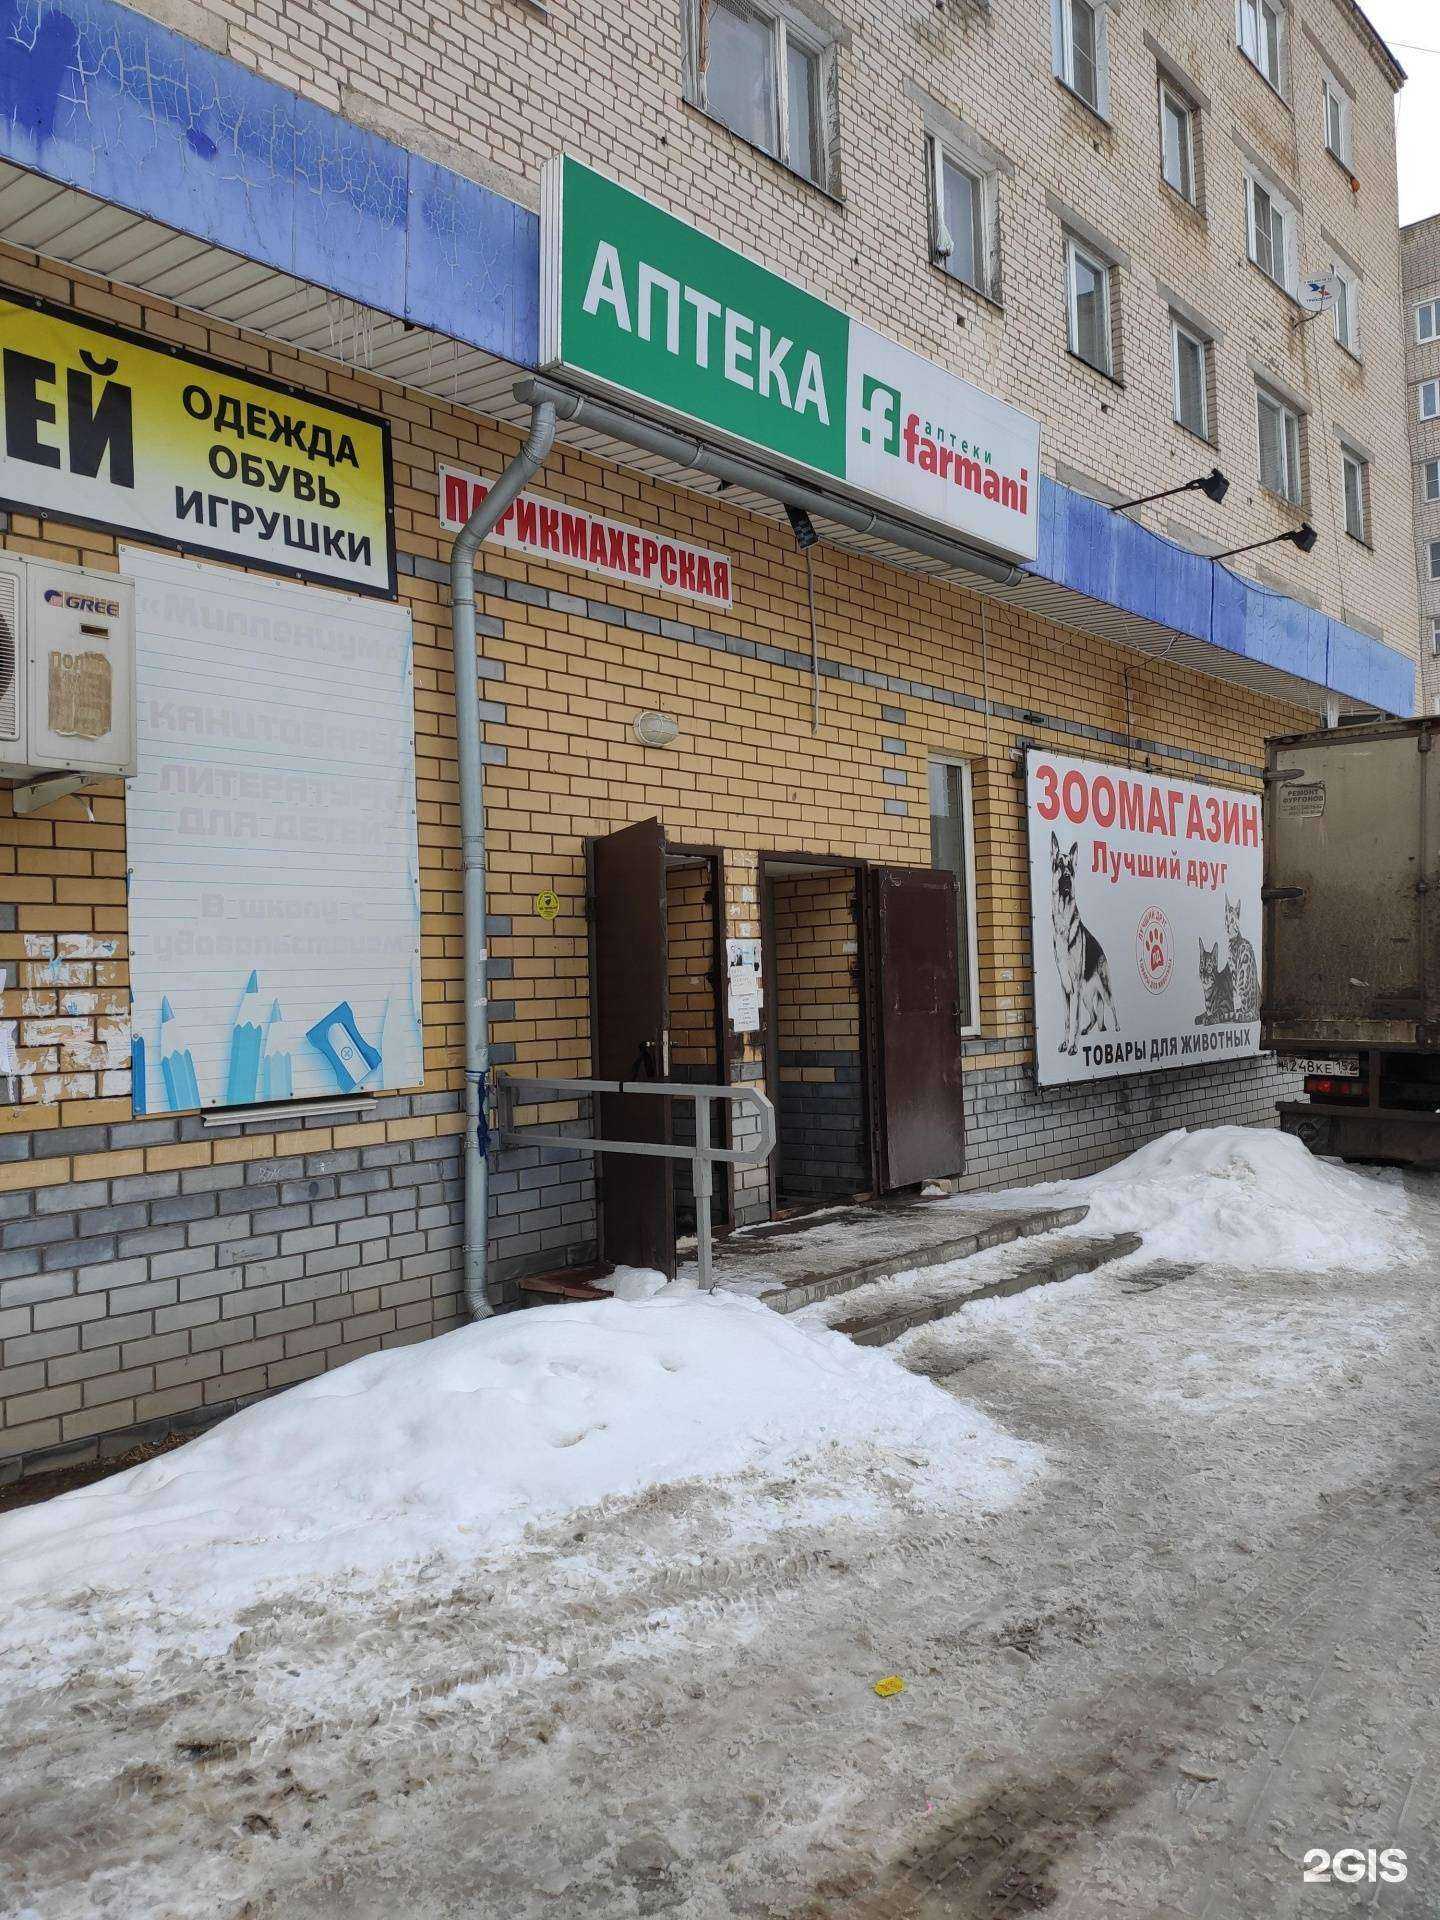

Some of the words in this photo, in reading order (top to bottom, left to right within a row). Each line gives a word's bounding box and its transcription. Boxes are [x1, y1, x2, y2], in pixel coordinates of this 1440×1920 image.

[581, 239, 830, 426] АПТЕКА
[181, 384, 360, 469] ОДЕЖДА
[924, 420, 992, 465] аптеки
[208, 444, 341, 509] ОБУВЬ
[903, 413, 1028, 515] farmani
[174, 485, 373, 567] ИГРУШКИ
[65, 595, 120, 618] GREE
[1035, 764, 1259, 848] ЗООМАГАЗИН
[1091, 840, 1182, 884] Лучший
[1186, 859, 1229, 891] друг
[1082, 1041, 1147, 1067] ТОВАРЫ
[1150, 1037, 1178, 1062] ДЛЯ
[1180, 1028, 1251, 1054] ЖИВОТНЫХ
